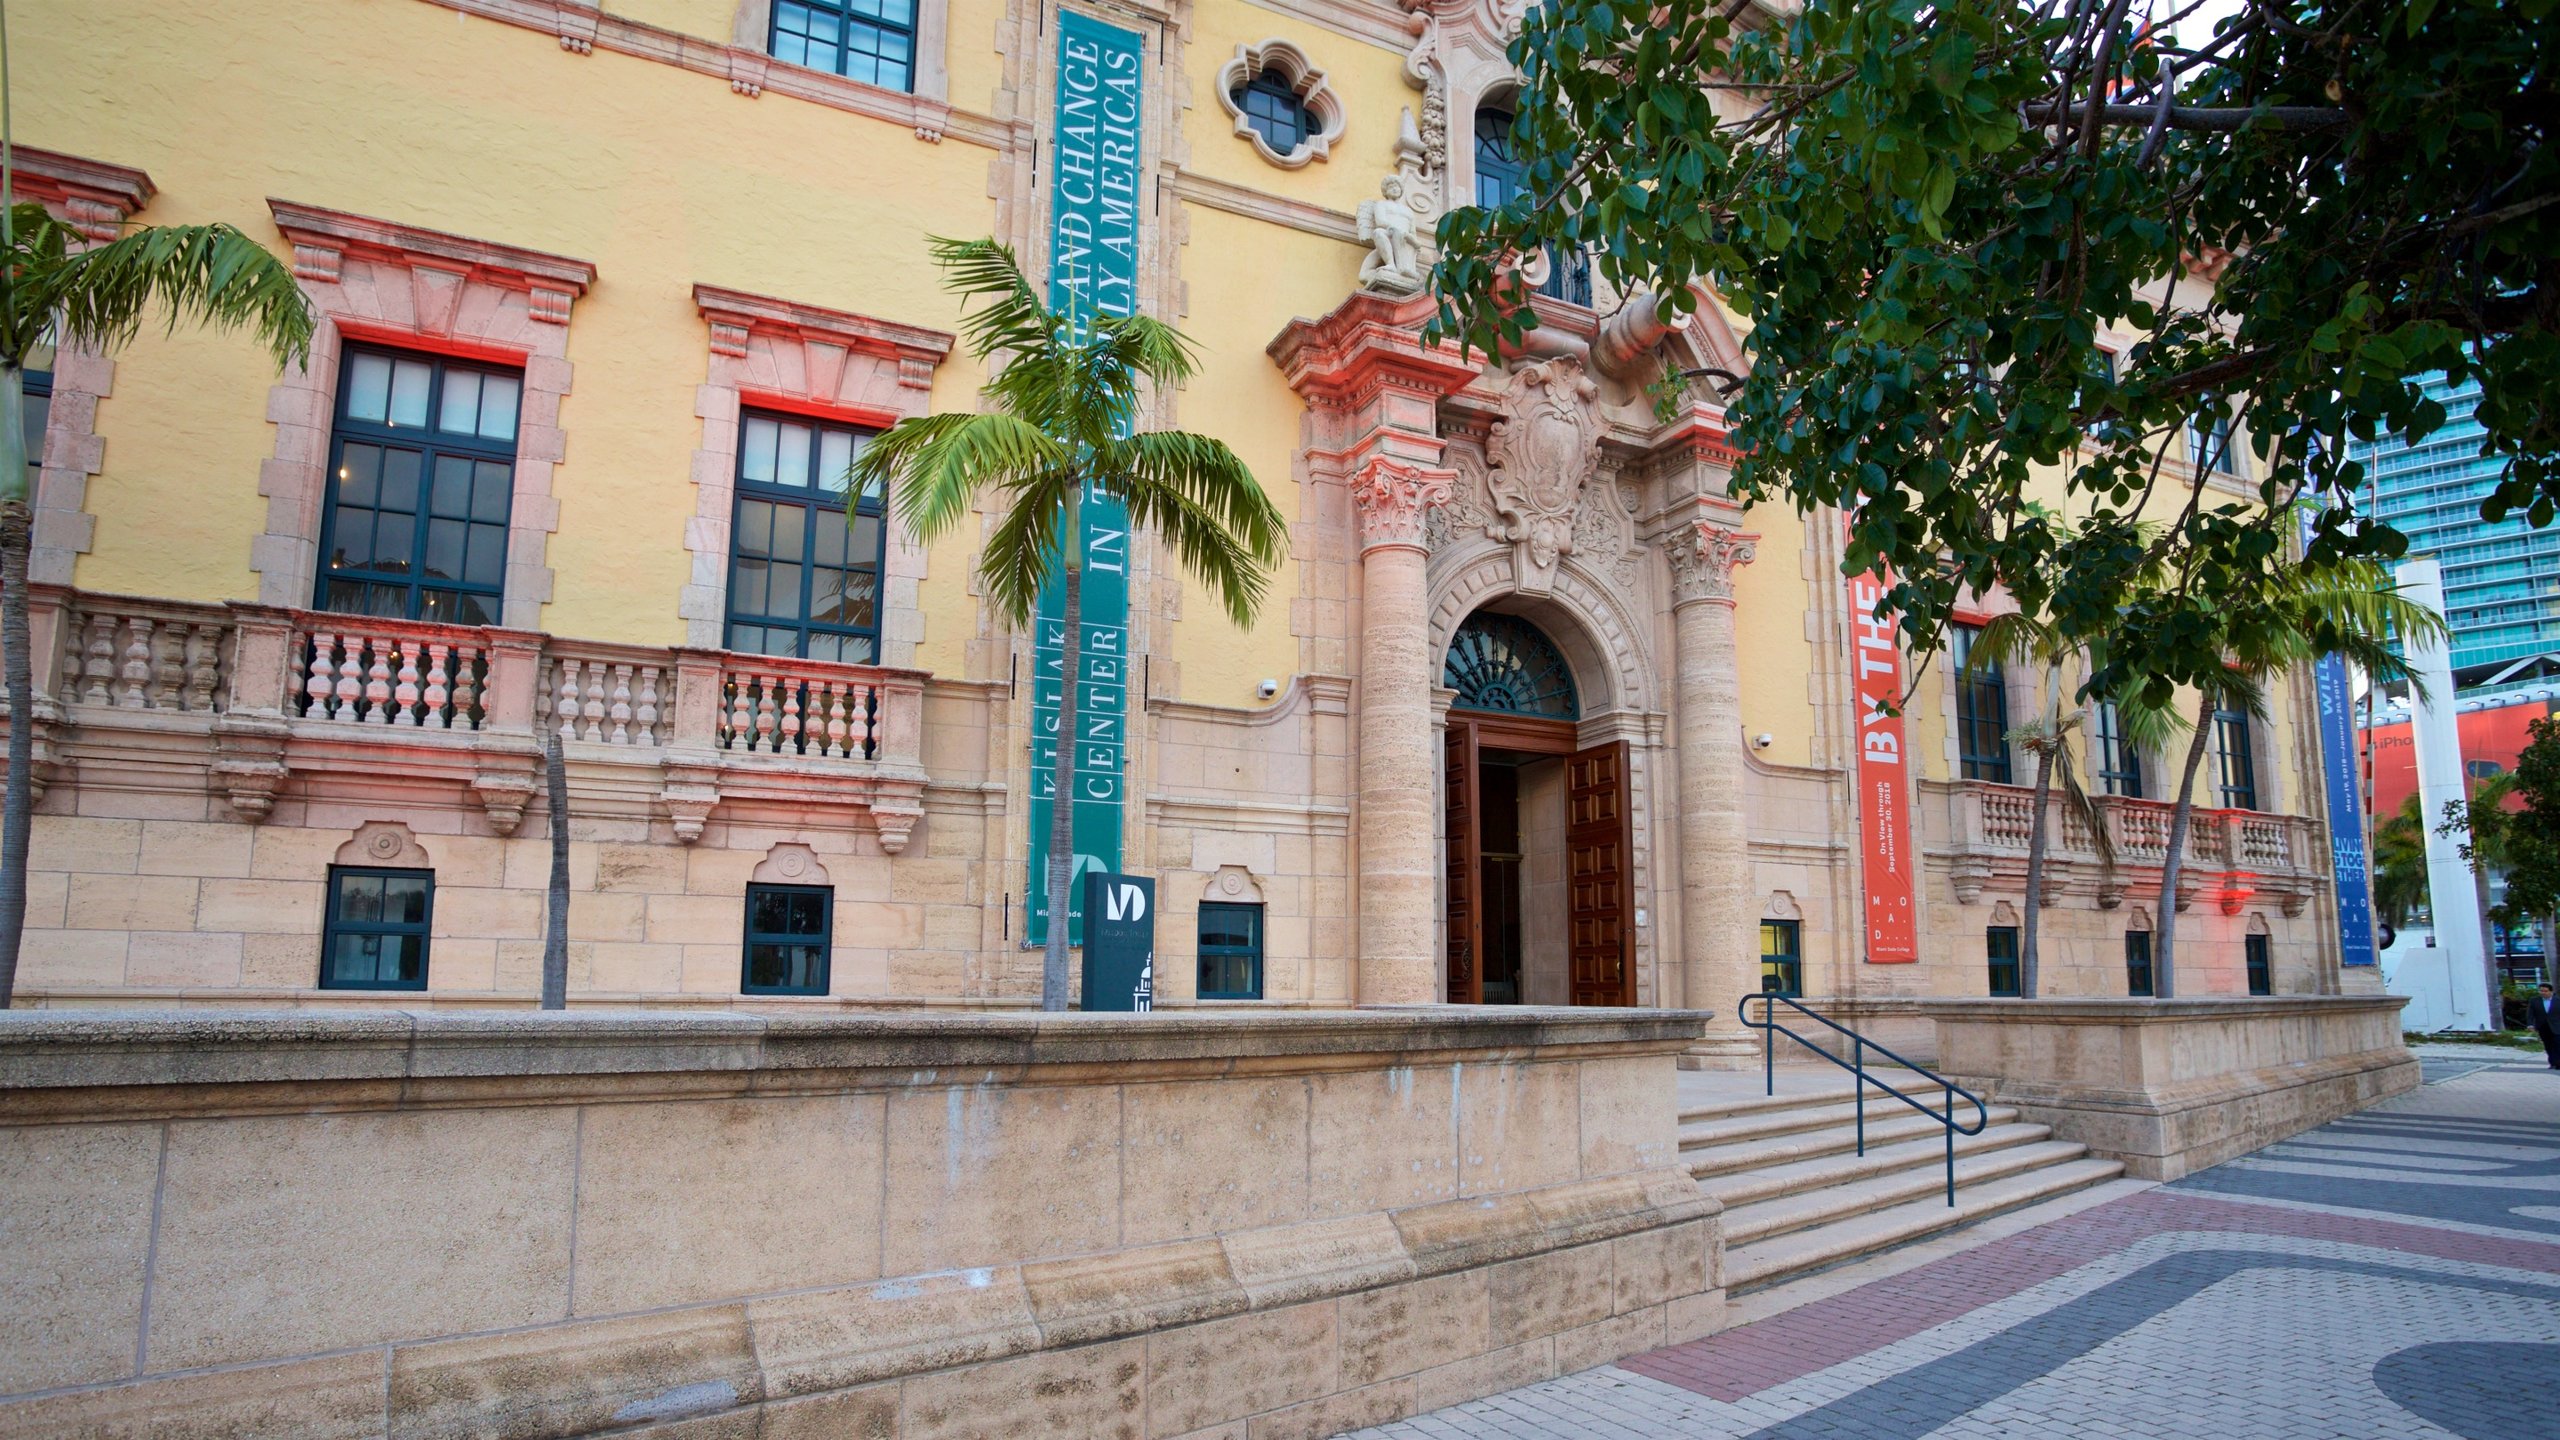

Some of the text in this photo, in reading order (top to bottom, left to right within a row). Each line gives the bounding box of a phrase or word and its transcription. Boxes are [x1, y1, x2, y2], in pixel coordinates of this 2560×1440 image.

[1061, 36, 1100, 205] CHANGE
[1100, 49, 1138, 262] AMERICAS
[1057, 213, 1092, 302] AND
[1089, 524, 1124, 576] IN
[1087, 630, 1118, 799] CENTER
[1855, 581, 1898, 764] BY THE
[1880, 842, 1886, 855] On
[1887, 823, 1895, 873] September
